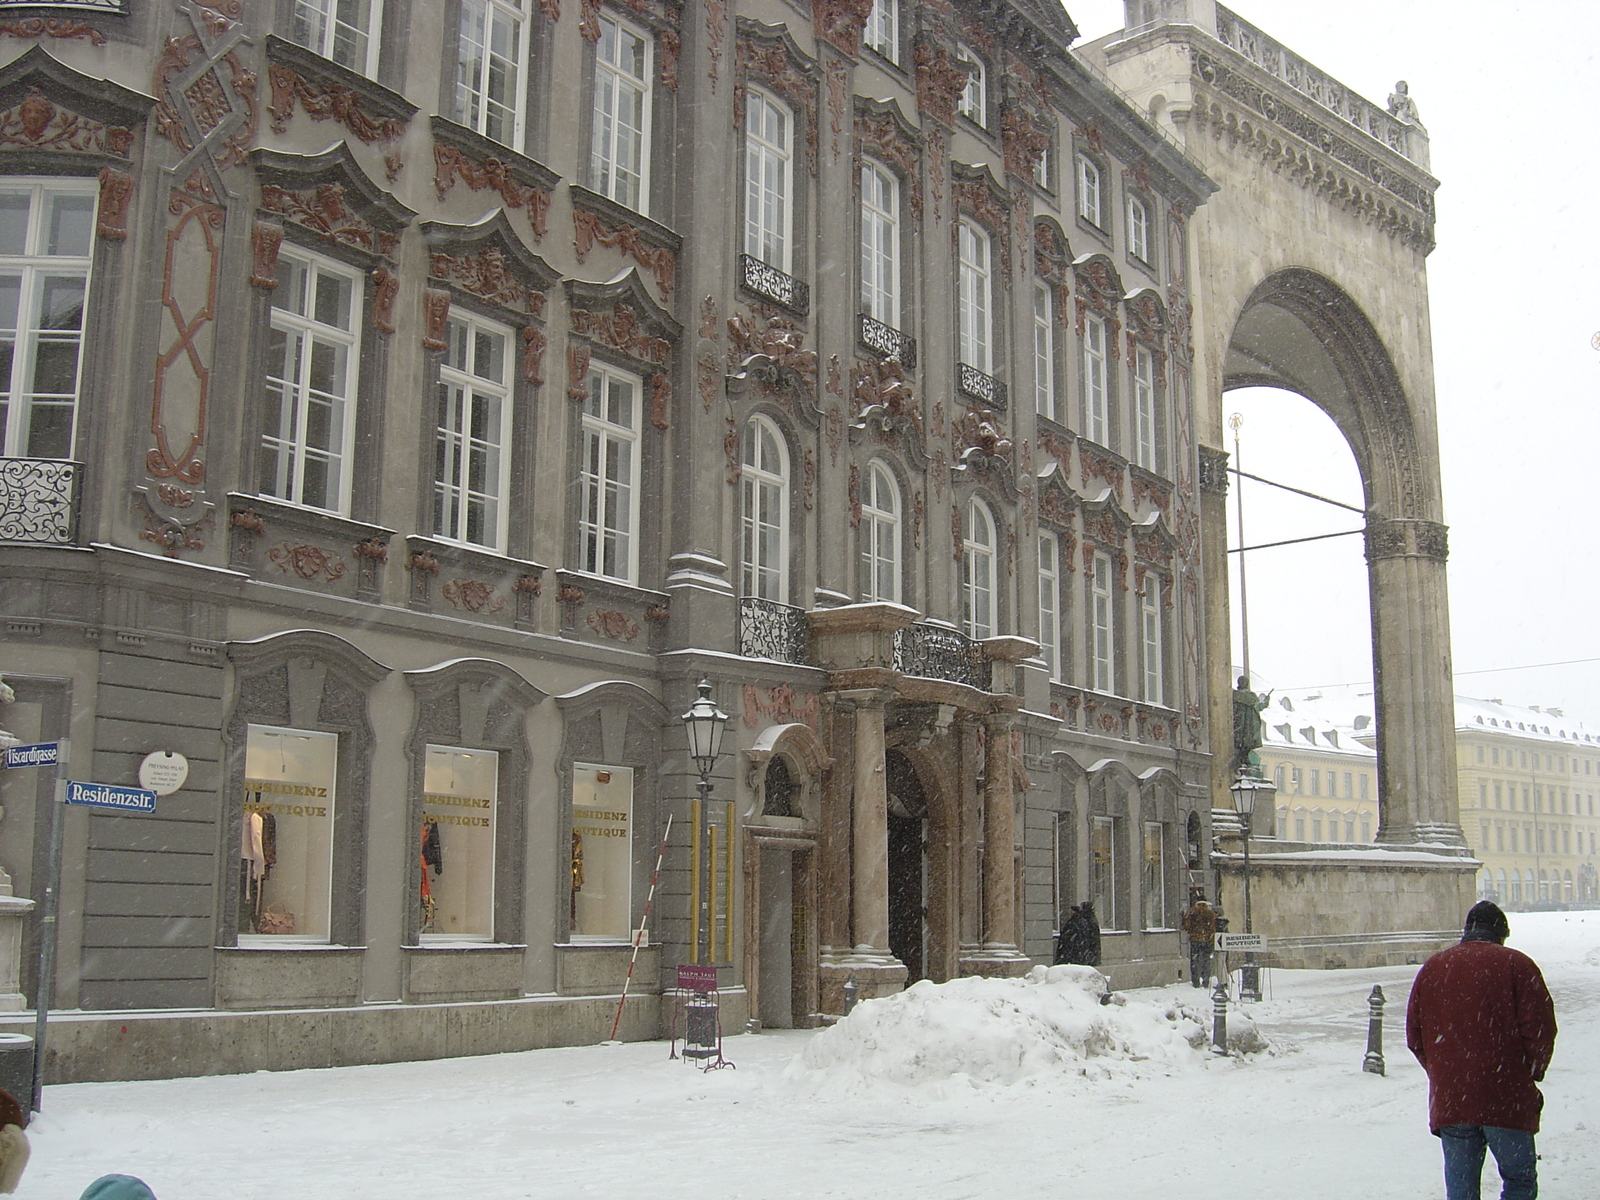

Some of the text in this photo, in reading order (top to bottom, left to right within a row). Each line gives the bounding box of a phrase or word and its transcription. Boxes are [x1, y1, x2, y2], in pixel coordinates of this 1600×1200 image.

[8, 747, 57, 765] Viscardigasse
[72, 784, 152, 808] Residenzstr.
[573, 809, 627, 822] ESIDENZ
[572, 826, 626, 838] OUTIQUE
